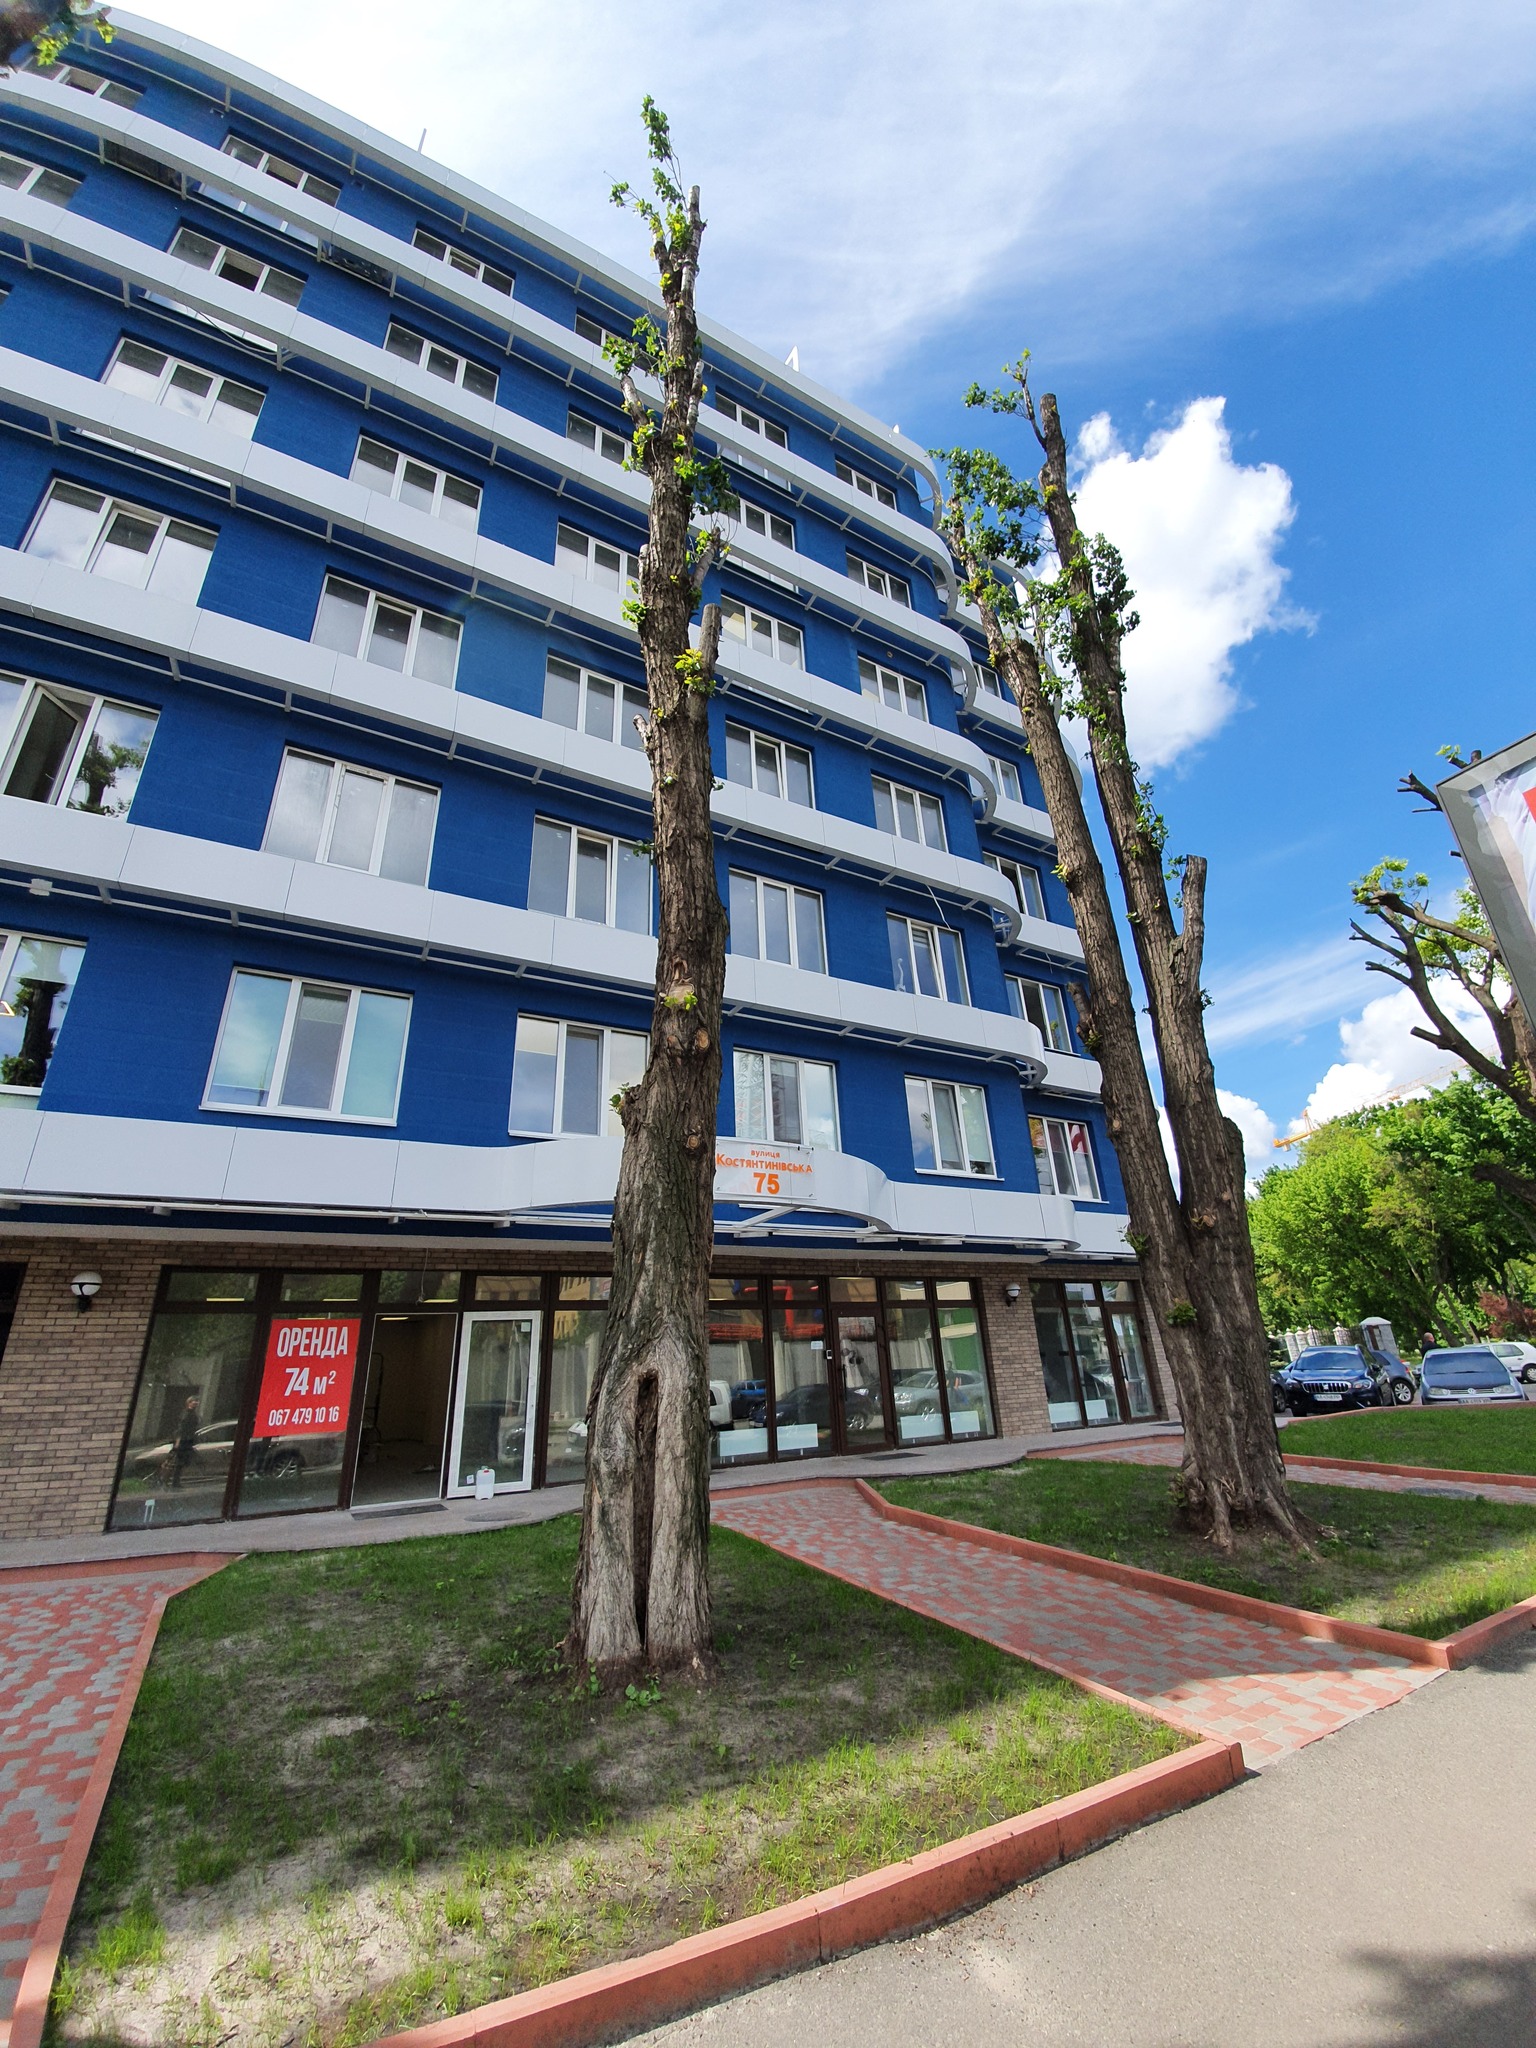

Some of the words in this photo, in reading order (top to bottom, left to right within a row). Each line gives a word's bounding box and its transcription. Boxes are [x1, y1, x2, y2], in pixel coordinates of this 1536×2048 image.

[750, 1149, 781, 1159] вулиця
[753, 1172, 780, 1195] 75
[276, 1326, 349, 1359] ОРЕНДА
[284, 1367, 310, 1397] 74
[268, 1408, 291, 1427] 067
[291, 1407, 313, 1425] 479
[315, 1406, 327, 1423] 10
[328, 1405, 340, 1422] 16
